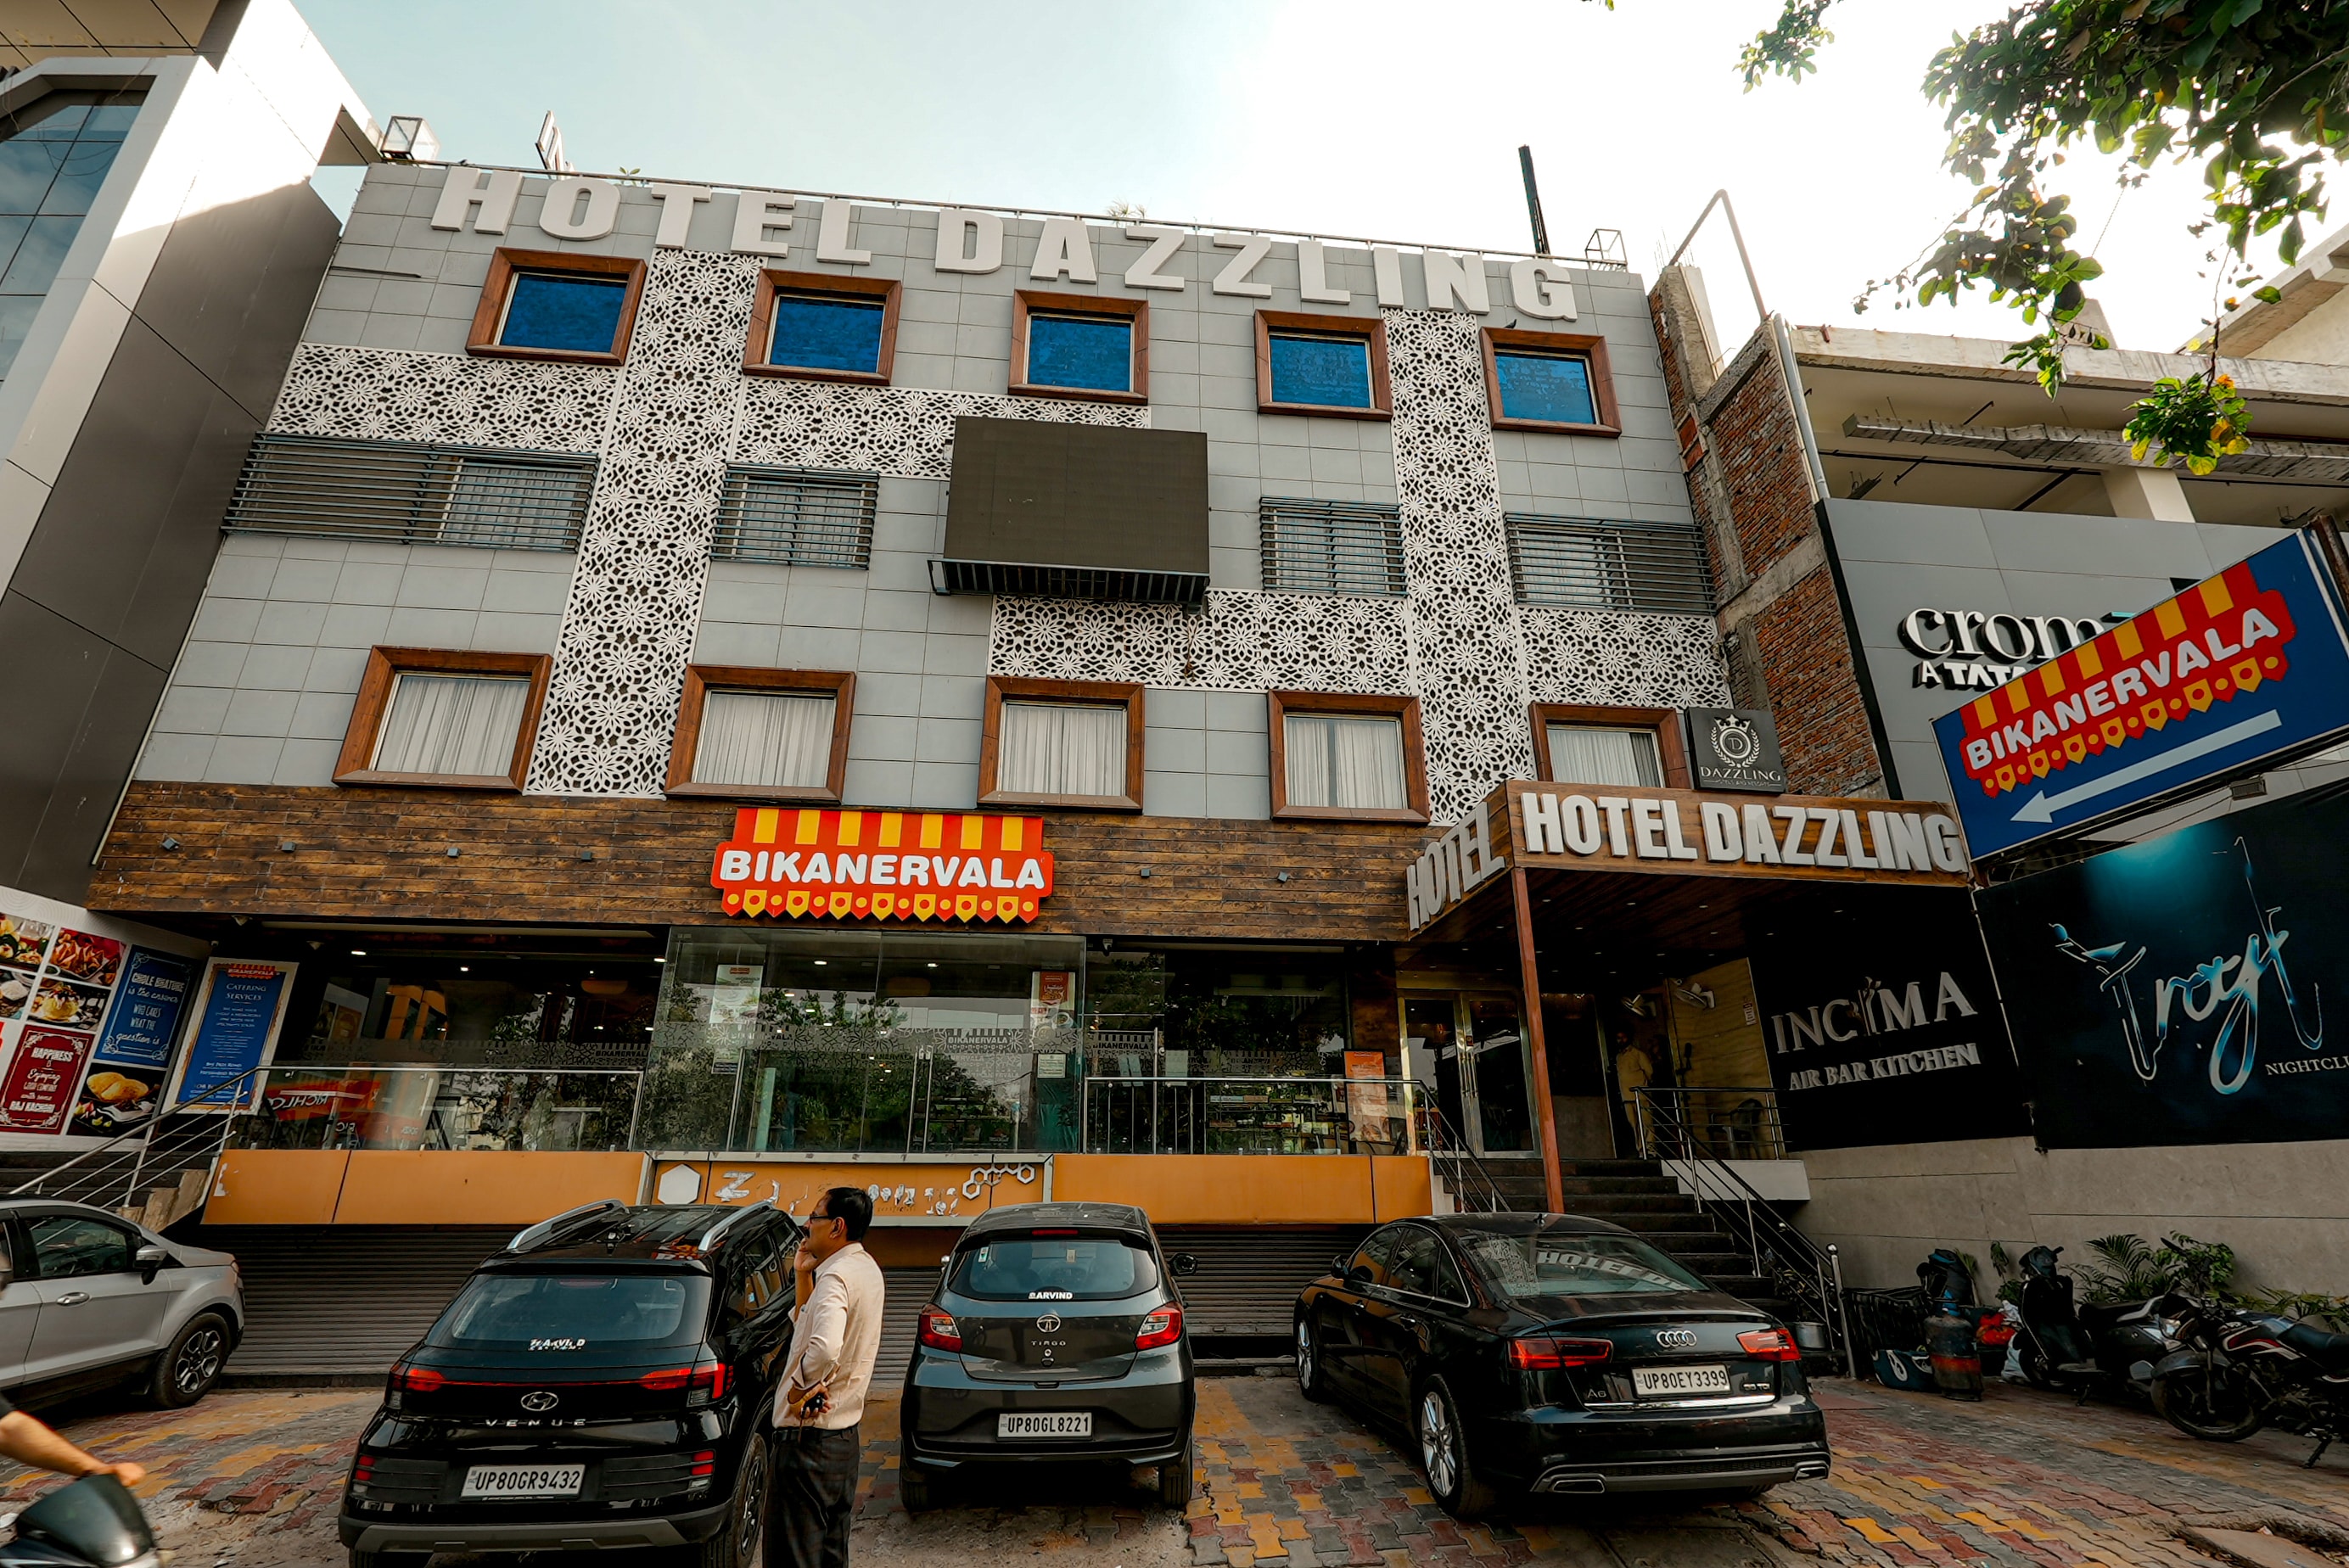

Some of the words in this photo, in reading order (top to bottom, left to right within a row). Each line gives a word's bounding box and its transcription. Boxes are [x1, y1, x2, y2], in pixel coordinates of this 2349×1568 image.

[431, 167, 872, 266] HOTEL
[935, 209, 1578, 322] DAZZLING
[1899, 608, 2106, 664] crom
[1965, 608, 2280, 770] BIKANERVALA
[1700, 765, 1781, 781] DAZZLING
[1522, 792, 1698, 861] HOTEL
[1700, 801, 1969, 874] DAZZLING
[720, 849, 1046, 889] BIKANERVALA
[1405, 801, 1505, 931] HOTEL
[225, 992, 261, 1001] SERVICES
[226, 983, 266, 992] CATERING
[1789, 1069, 1825, 1091] AIR
[1824, 1061, 1873, 1086] BAR
[1869, 1042, 1982, 1079] KITCHEN
[1036, 1291, 1073, 1300] ARVIND
[1644, 1369, 1729, 1390] UP80EY3399
[1587, 1388, 1606, 1398] A6
[485, 1418, 586, 1427] VENUE
[1007, 1416, 1089, 1433] UP80GL8221
[475, 1470, 580, 1491] UP80GR9432
